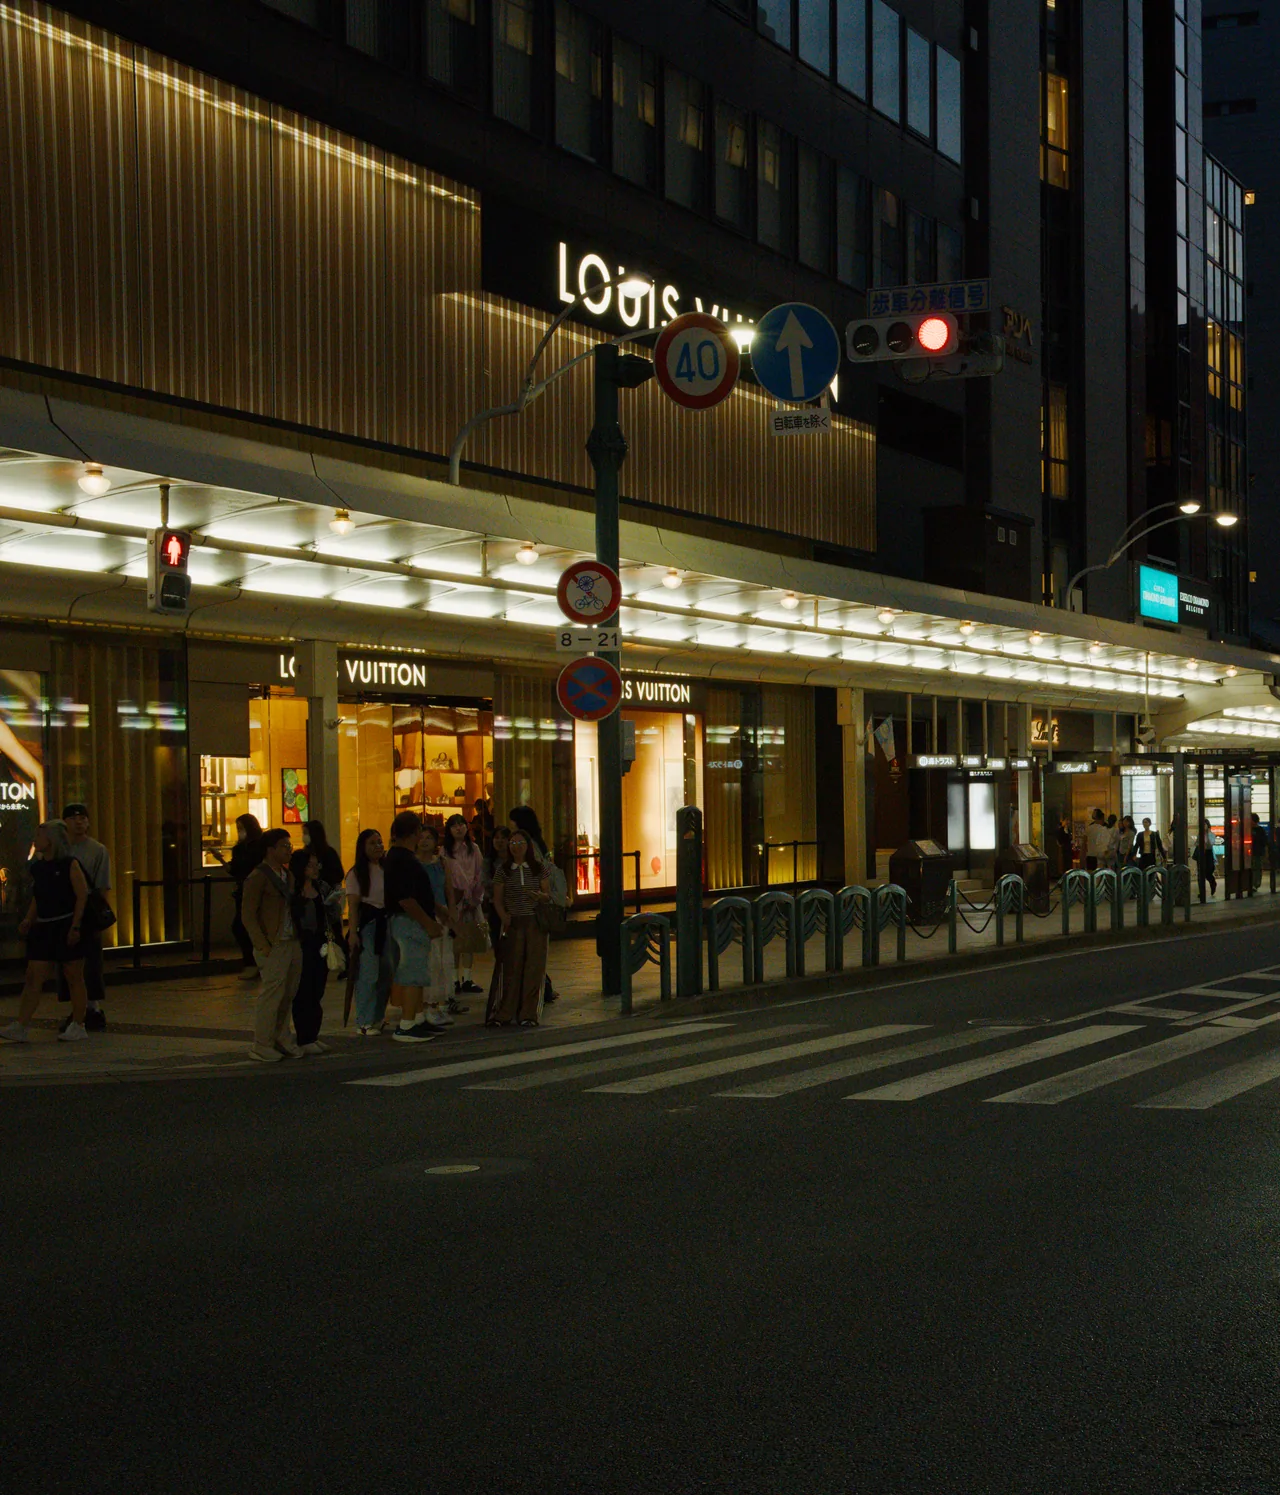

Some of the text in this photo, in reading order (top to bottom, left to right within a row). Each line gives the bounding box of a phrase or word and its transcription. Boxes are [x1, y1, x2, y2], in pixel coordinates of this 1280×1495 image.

[872, 284, 985, 316] 歩車分離信号
[675, 340, 720, 383] 40
[773, 413, 829, 431] 自転車を除く
[345, 659, 426, 688] VUITTON
[636, 681, 691, 703] VUITTON
